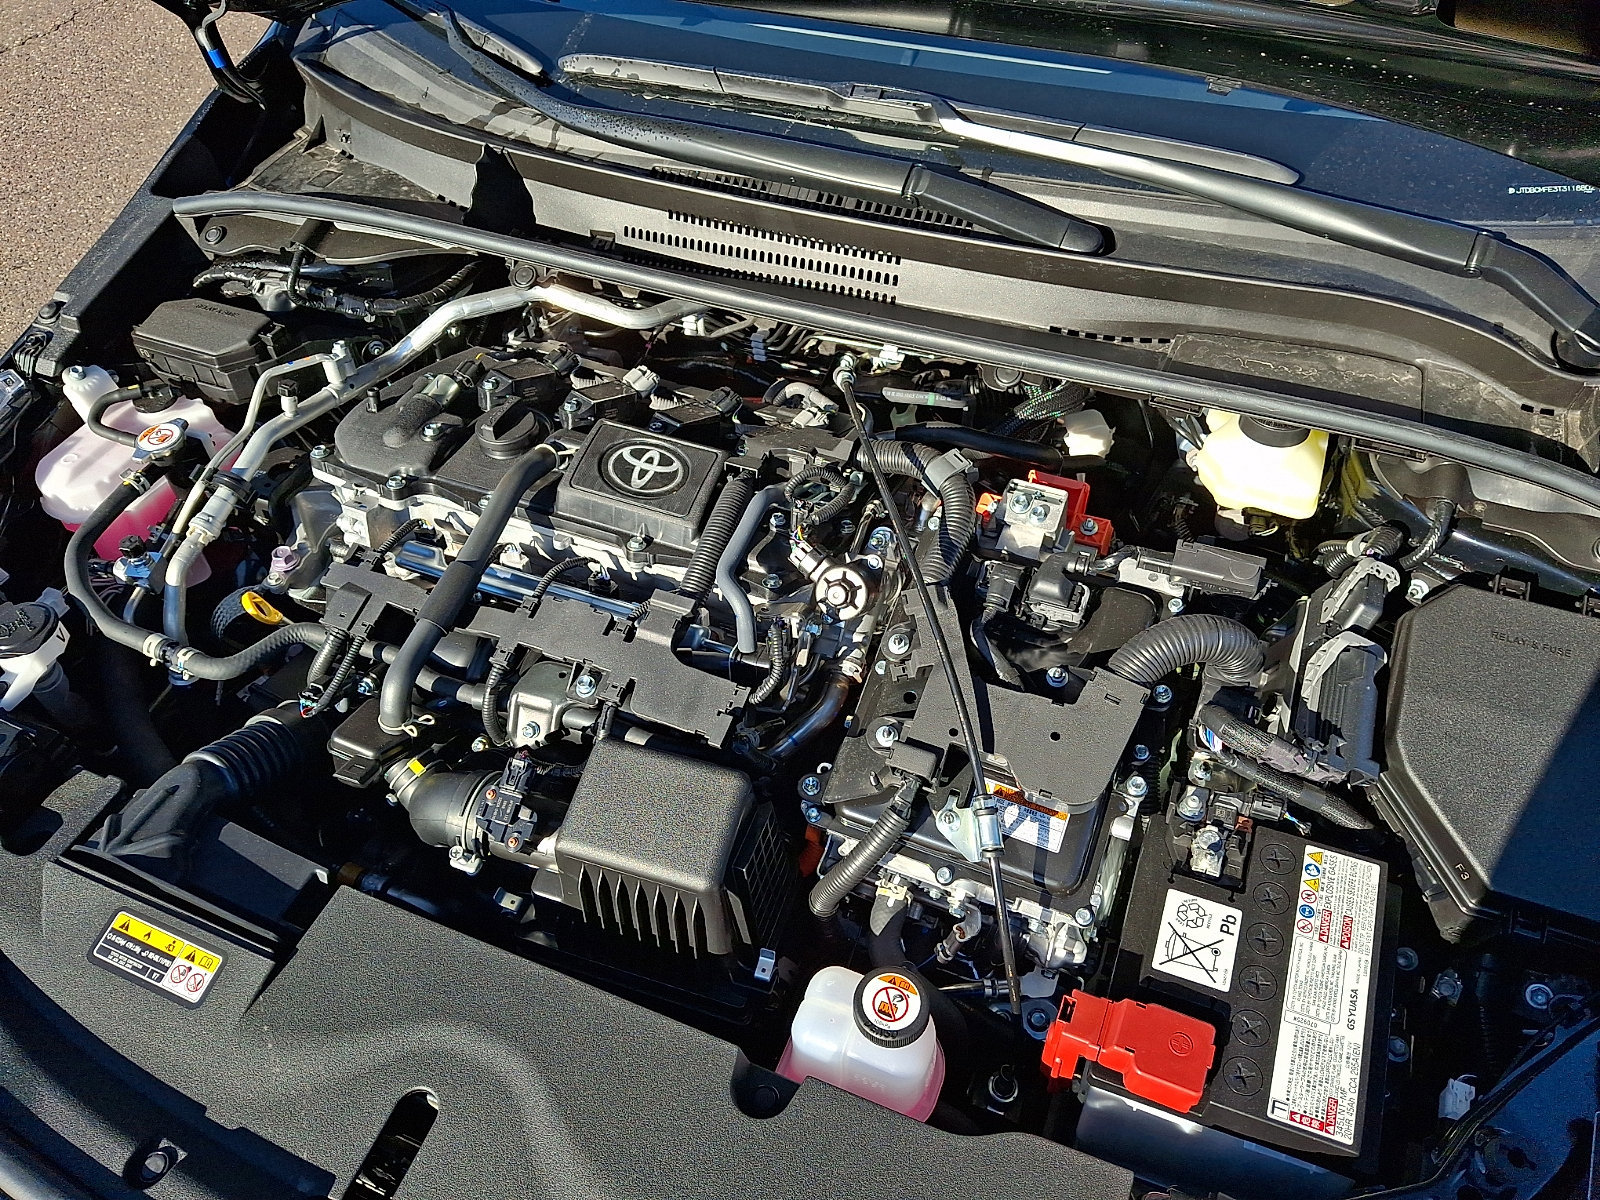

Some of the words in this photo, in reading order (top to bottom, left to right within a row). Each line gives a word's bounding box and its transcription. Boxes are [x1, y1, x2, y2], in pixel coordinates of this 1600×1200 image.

[1491, 631, 1528, 647] RELAY
[1531, 641, 1539, 650] &
[1542, 643, 1572, 658] FUSE
[1328, 854, 1338, 876] GASES
[1455, 863, 1470, 880] F3
[1323, 875, 1336, 909] EXPLOSIVE
[1219, 914, 1237, 936] Pb
[1320, 909, 1331, 935] DANGER
[1341, 915, 1352, 942] POISON
[1347, 987, 1359, 1019] YUASA
[1346, 1017, 1355, 1030] GS
[1326, 1097, 1337, 1125] DANGER
[1343, 1117, 1353, 1140] 20HR
[1348, 1075, 1357, 1094] CCA
